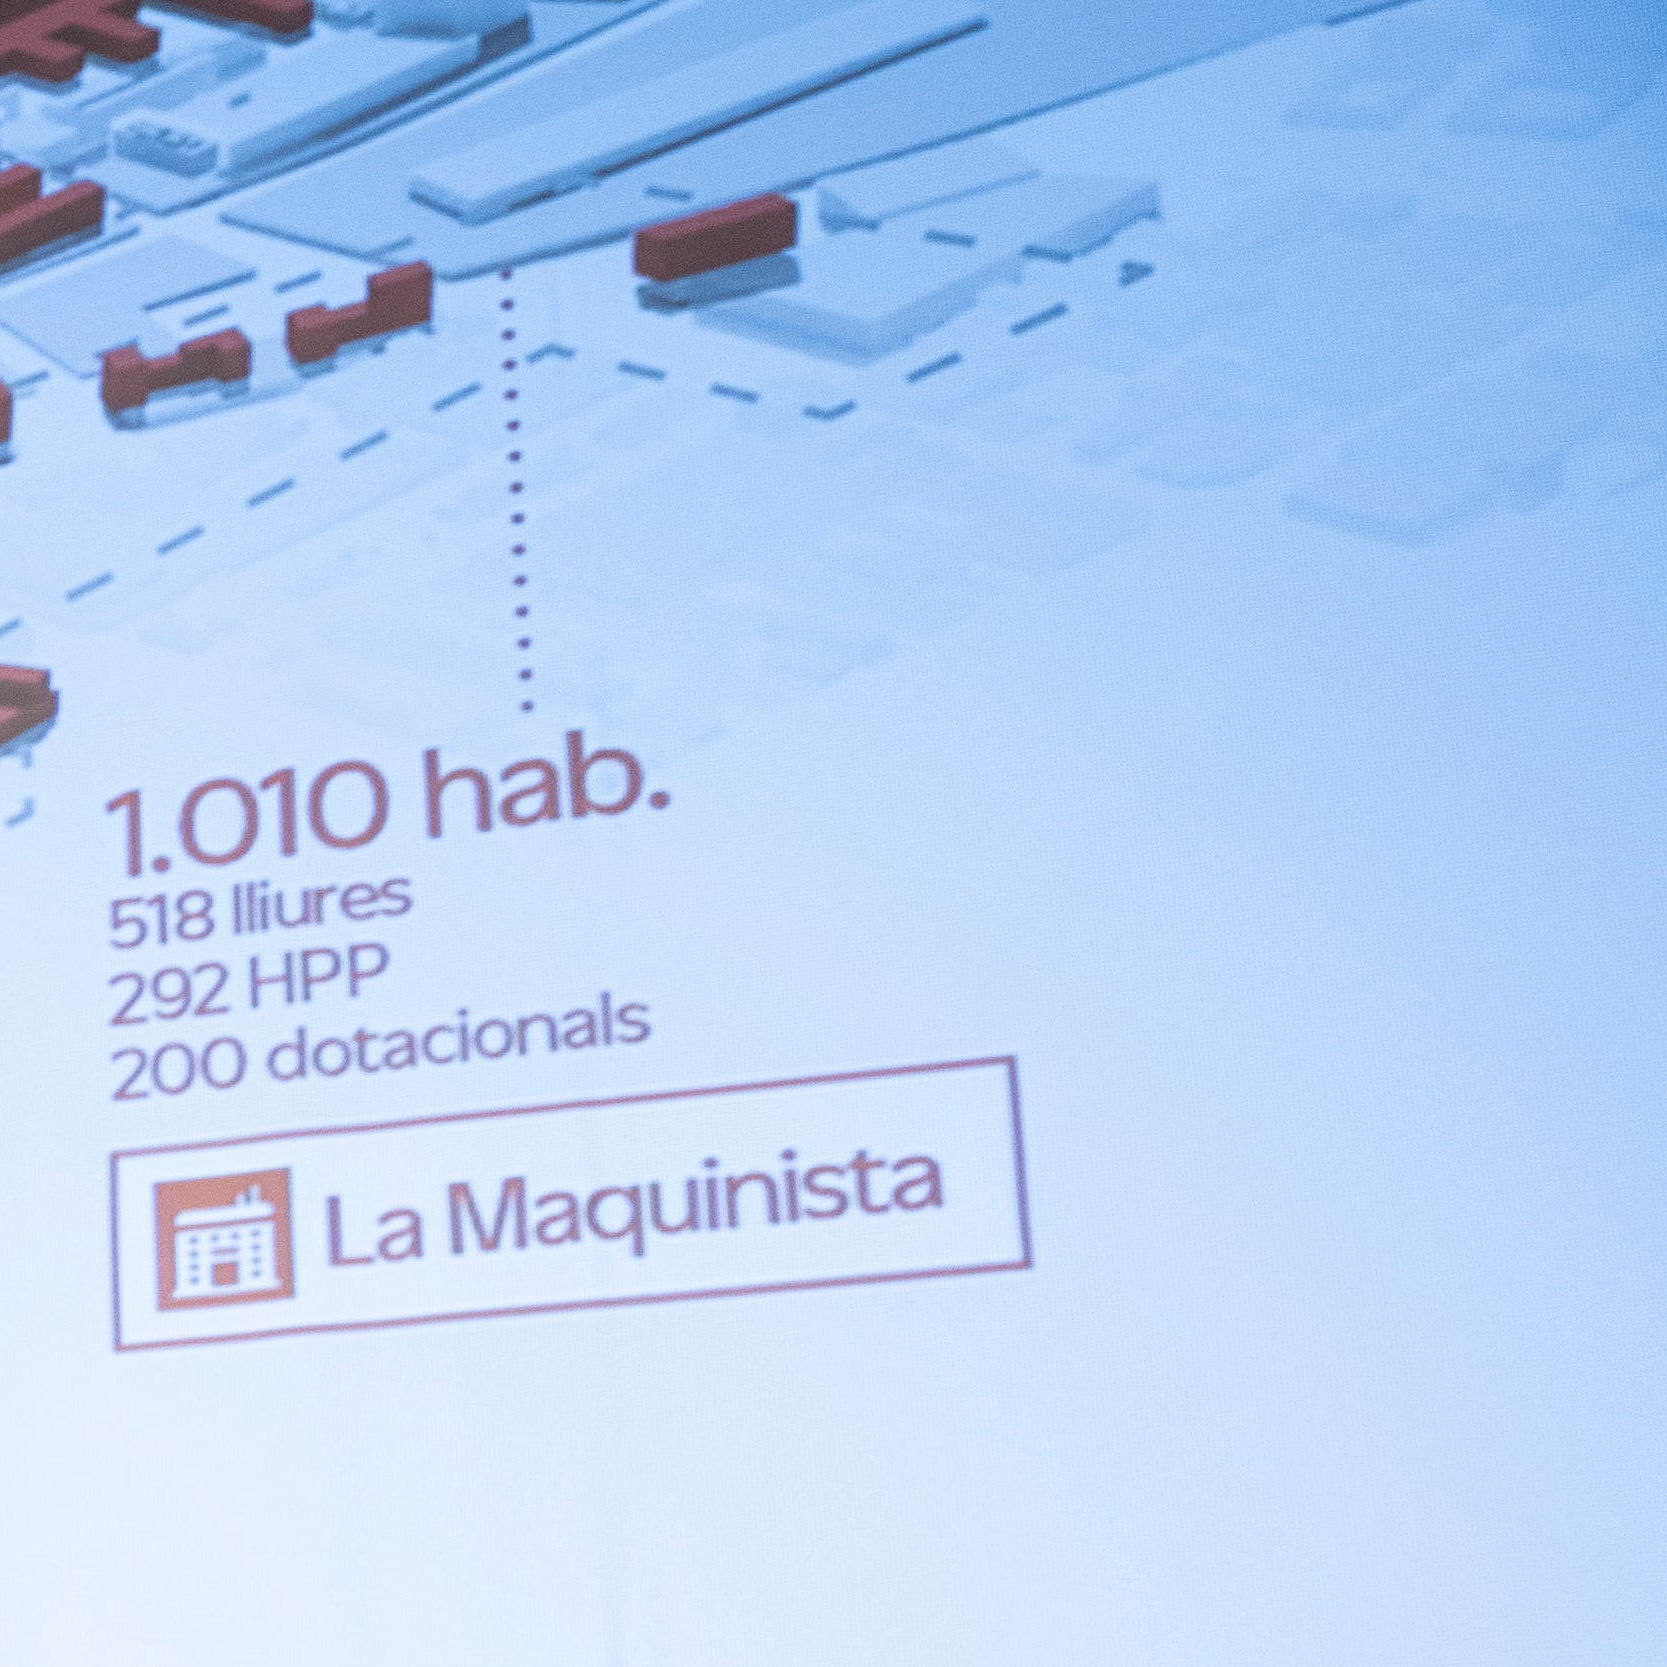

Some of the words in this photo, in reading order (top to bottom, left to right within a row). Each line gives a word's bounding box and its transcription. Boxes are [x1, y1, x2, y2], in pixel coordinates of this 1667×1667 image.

[106, 759, 389, 878] 1.010
[424, 730, 671, 839] hab.
[109, 889, 214, 950] 518
[233, 873, 412, 936] lliures
[110, 962, 230, 1027] 292
[249, 941, 389, 1009] HPP
[112, 1036, 247, 1102] 200
[267, 991, 651, 1083] dotacionals
[325, 1194, 424, 1268] La
[447, 1147, 944, 1258] Maquinista
